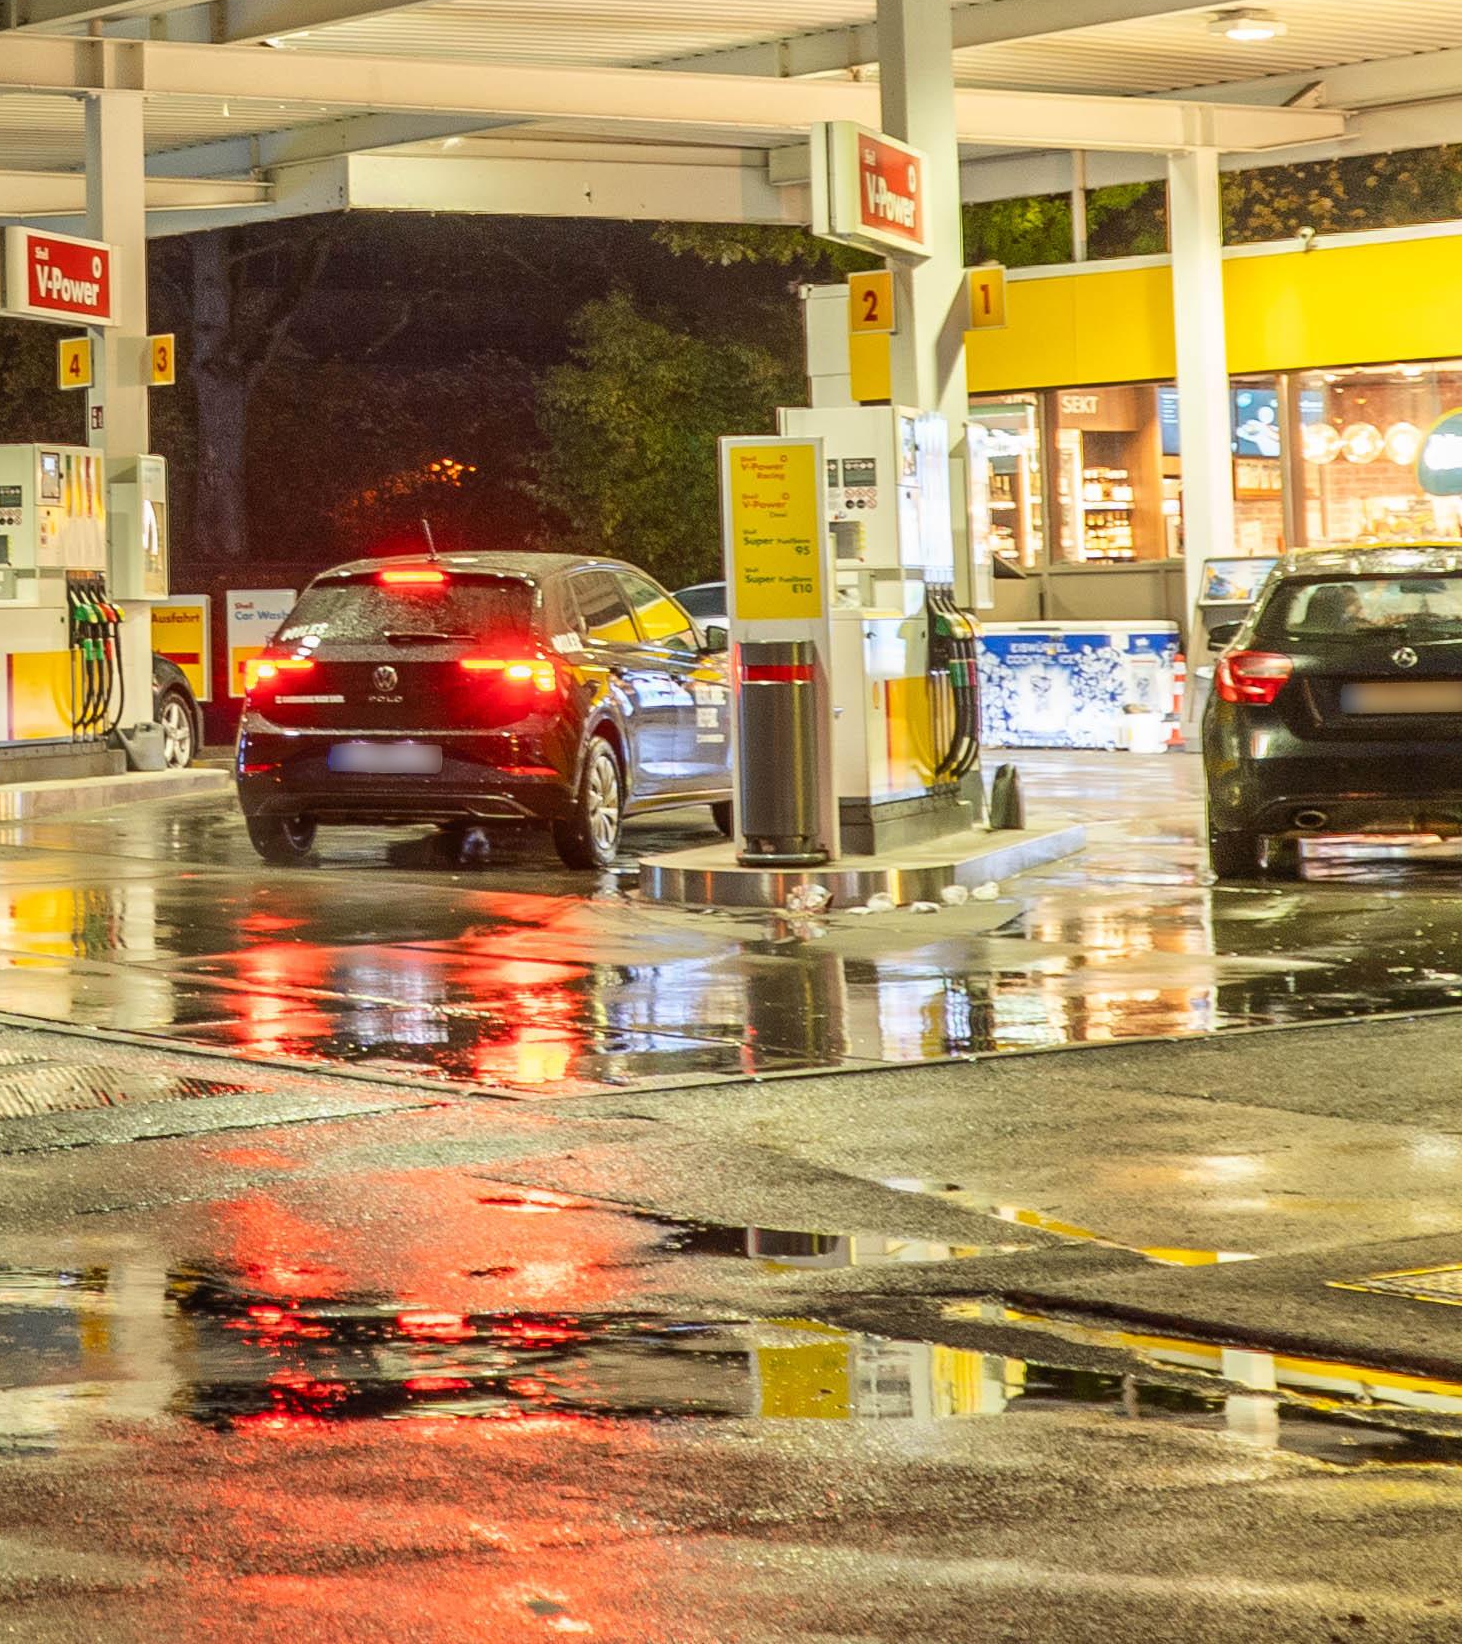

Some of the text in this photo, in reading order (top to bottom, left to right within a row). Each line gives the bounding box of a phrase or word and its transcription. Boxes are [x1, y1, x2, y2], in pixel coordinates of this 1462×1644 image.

[865, 171, 915, 229] V-Power
[35, 263, 100, 306] V-Power
[862, 290, 878, 321] 2
[980, 284, 991, 314] 1
[69, 353, 80, 377] 4
[157, 346, 168, 372] 3
[1061, 395, 1100, 414] SEKT
[743, 537, 774, 547] Super
[794, 546, 811, 555] 95
[744, 575, 776, 585] Super
[791, 583, 813, 593] E10
[151, 612, 200, 624] Ausfahrt
[234, 611, 254, 621] Car
